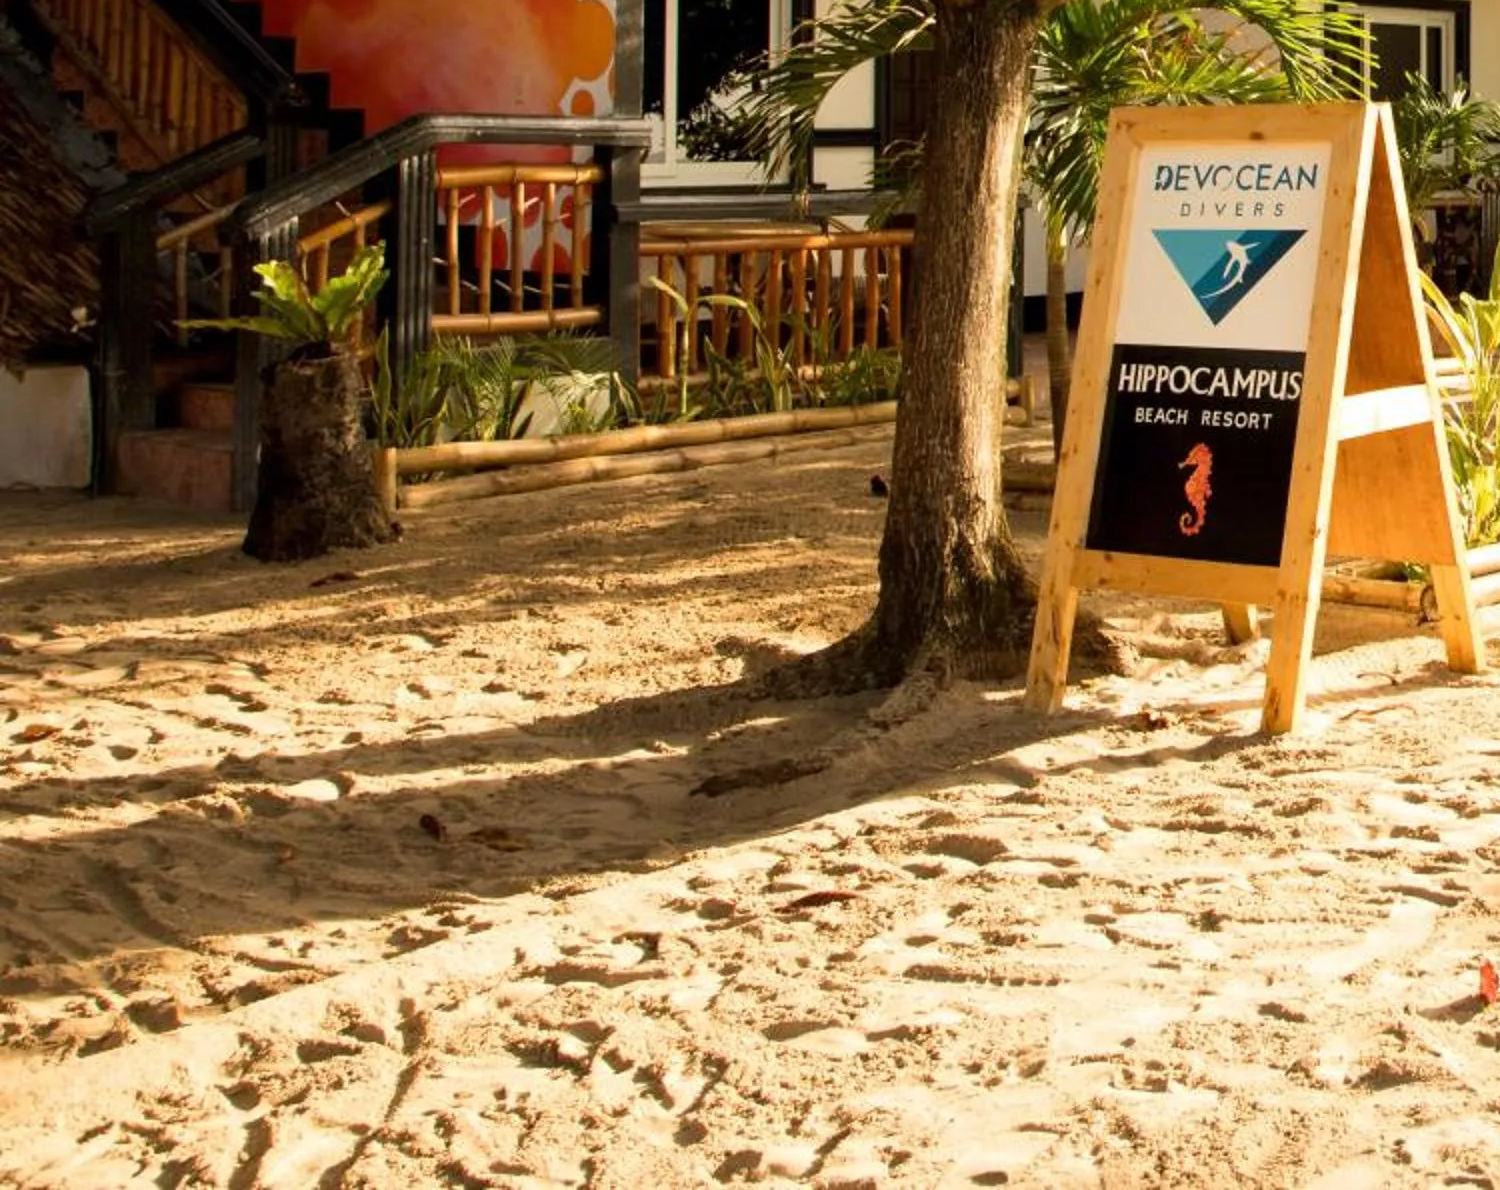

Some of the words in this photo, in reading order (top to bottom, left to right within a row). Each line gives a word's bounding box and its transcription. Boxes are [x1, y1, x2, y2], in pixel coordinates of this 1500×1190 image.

[1154, 163, 1318, 191] DEVOCEAN
[1180, 202, 1285, 217] DIVERS
[1118, 362, 1302, 402] HIPPOCAMPUS
[1134, 406, 1189, 426] BEACH
[1201, 410, 1273, 430] RESORT
